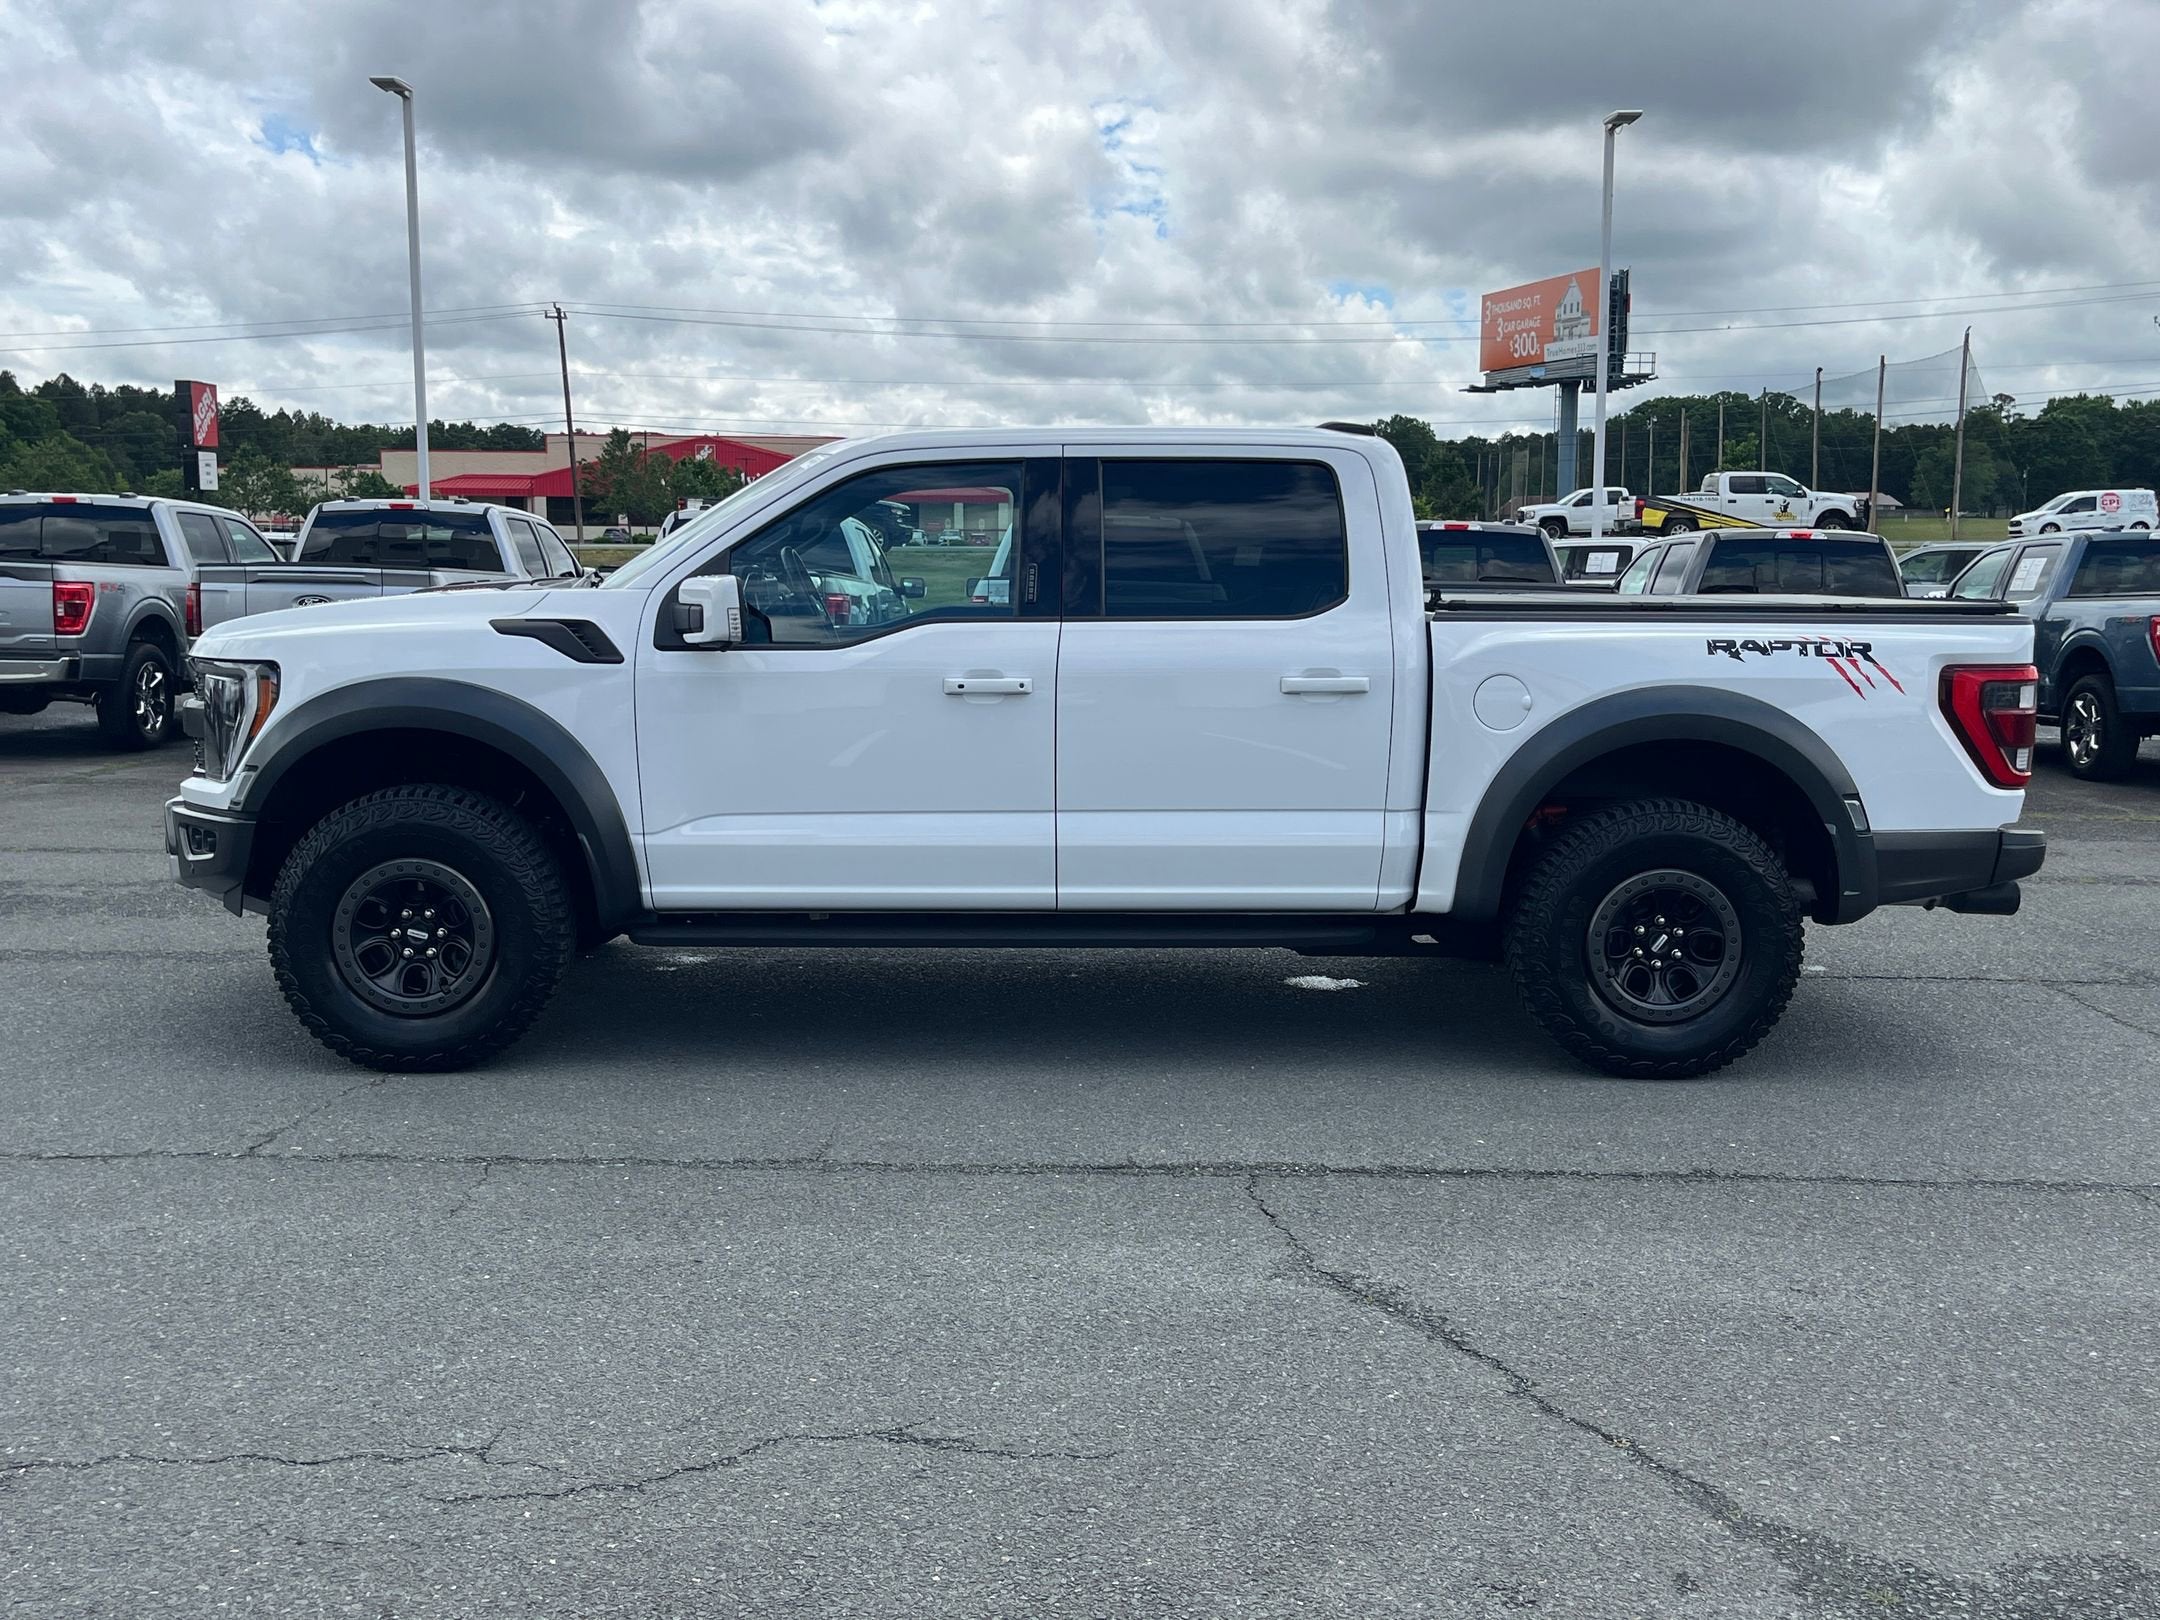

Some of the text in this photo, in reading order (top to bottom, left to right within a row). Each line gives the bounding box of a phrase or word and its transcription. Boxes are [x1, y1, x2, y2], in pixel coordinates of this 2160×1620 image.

[1485, 300, 1492, 324] 3
[1492, 298, 1522, 315] THOUSAND
[1496, 316, 1542, 342] 3 CAR GARAGE
[193, 386, 213, 432] AGRI
[197, 399, 217, 445] SUPPLY
[1706, 638, 1880, 665] RAPTOR
